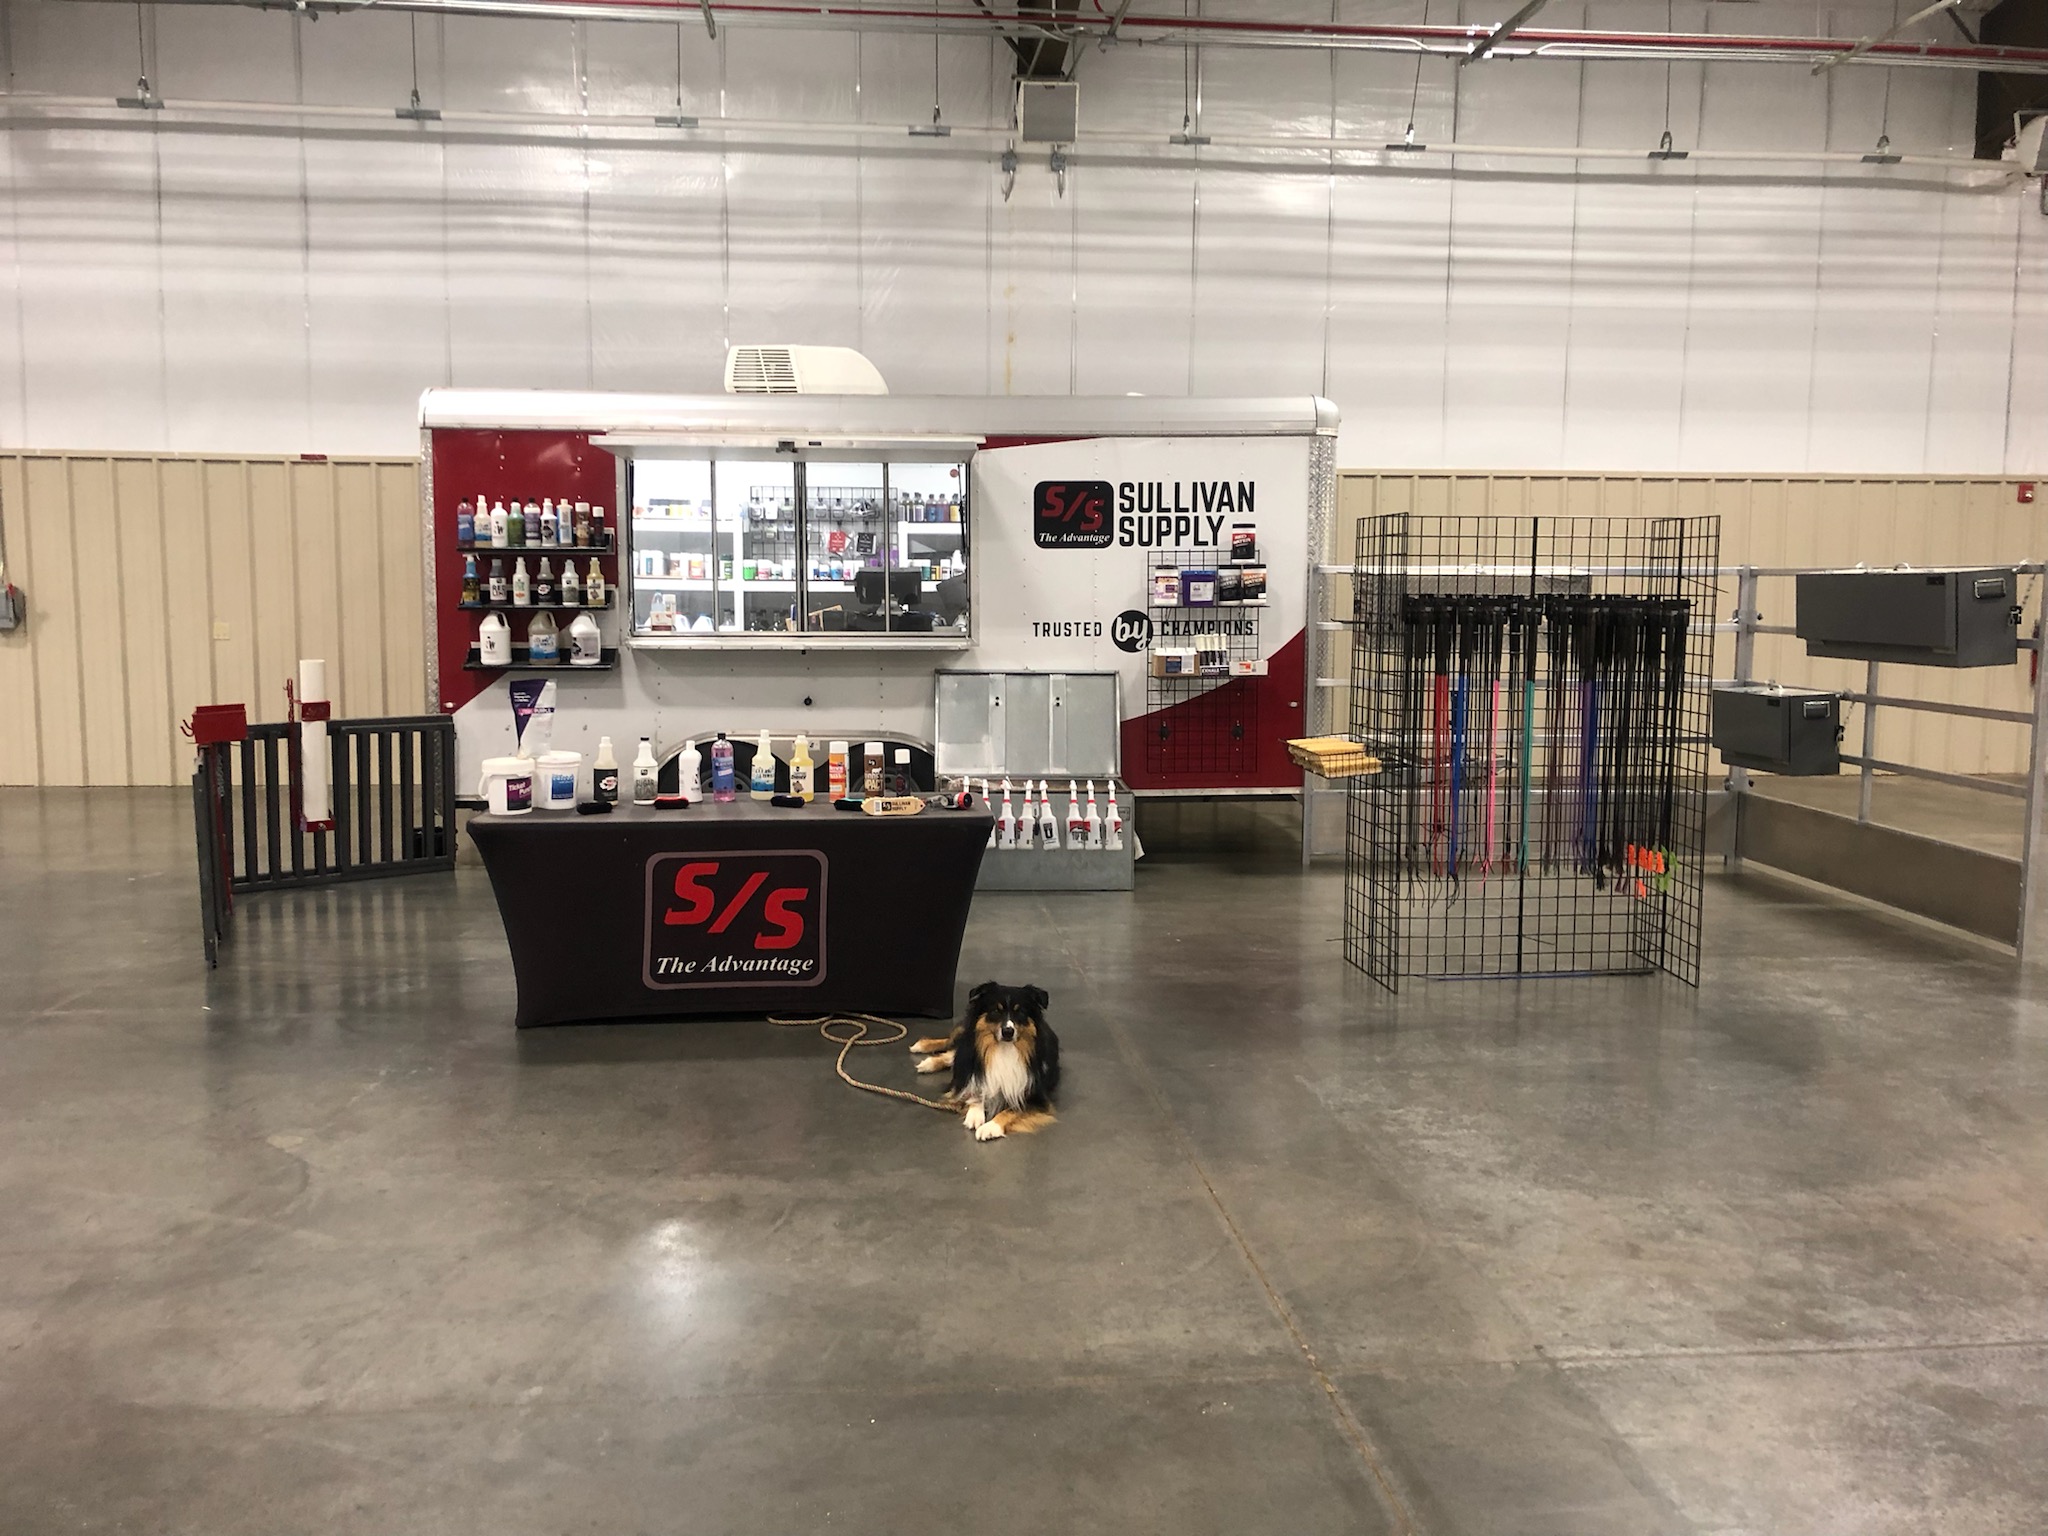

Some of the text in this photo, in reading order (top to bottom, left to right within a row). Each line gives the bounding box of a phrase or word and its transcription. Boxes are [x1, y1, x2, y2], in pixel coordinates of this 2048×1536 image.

[1041, 484, 1105, 531] S/S
[1119, 481, 1255, 513] SULLIVAN
[1038, 532, 1111, 545] The Advantage
[1119, 515, 1225, 547] SUPPLY
[1032, 617, 1254, 650] TRUSTED by CHAMPIONS
[508, 782, 526, 793] Ticket
[664, 862, 809, 950] S/S
[656, 954, 814, 976] The Advantage
